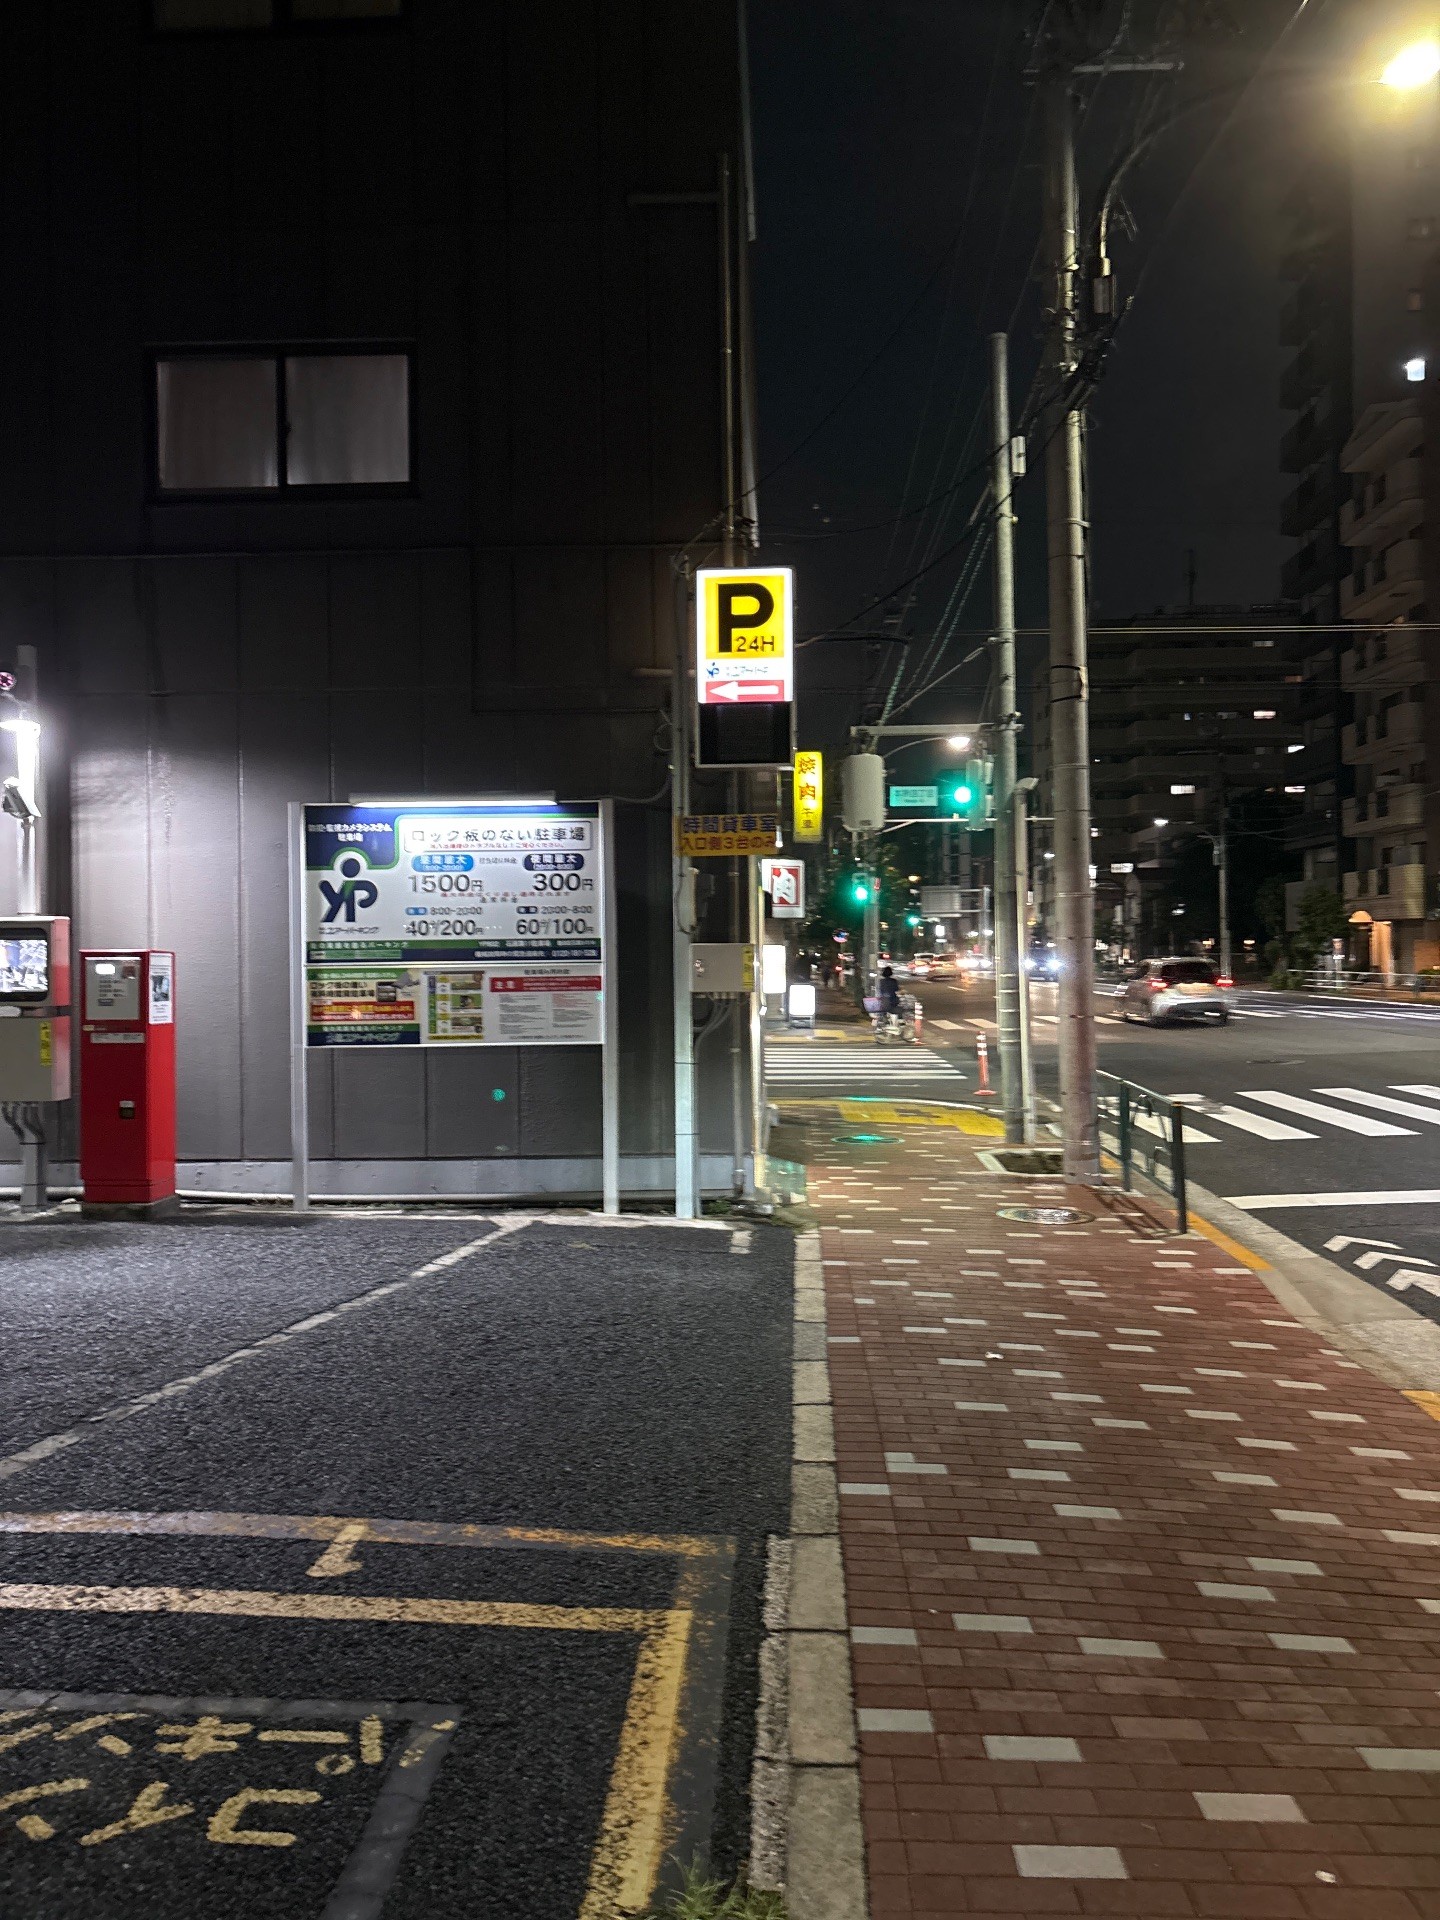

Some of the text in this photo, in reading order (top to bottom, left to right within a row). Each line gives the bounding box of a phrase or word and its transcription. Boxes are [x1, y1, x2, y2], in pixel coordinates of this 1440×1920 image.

[717, 581, 775, 653] P
[735, 635, 775, 653] 24H
[682, 815, 777, 834] 時間貸車室
[411, 826, 585, 842] ロック板のない駐車場
[408, 874, 484, 892] 1500円
[532, 873, 594, 891] 300円
